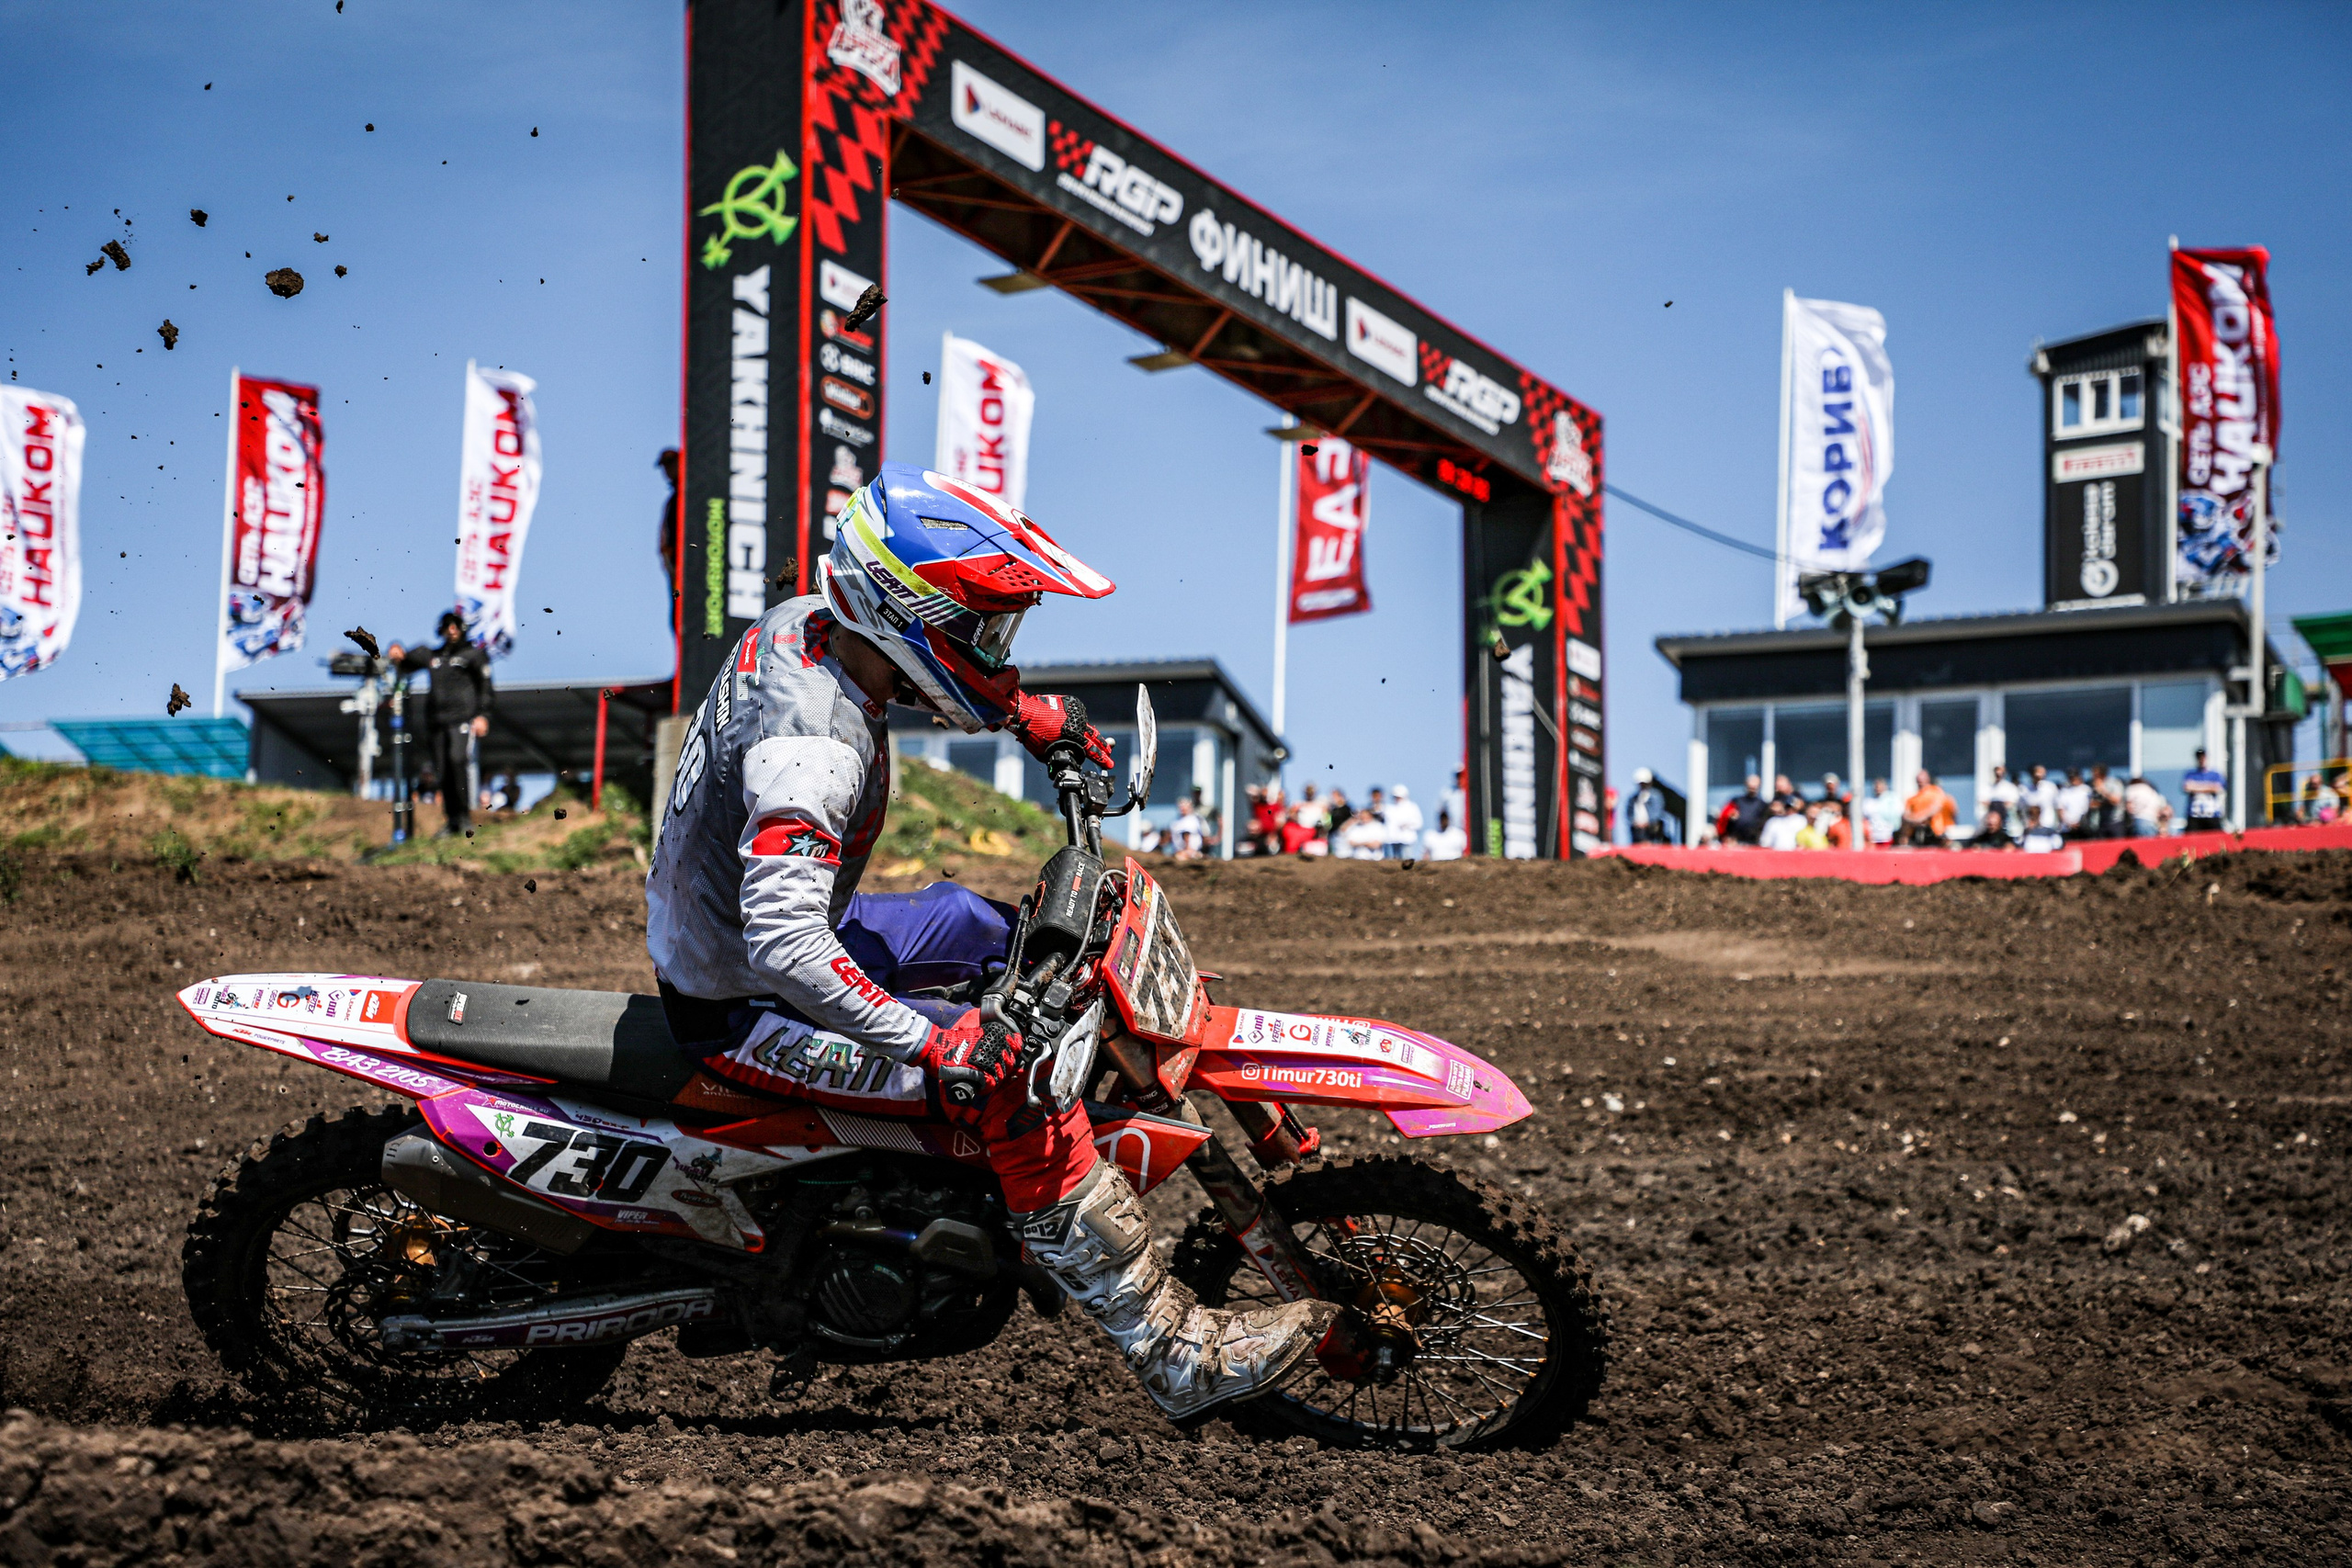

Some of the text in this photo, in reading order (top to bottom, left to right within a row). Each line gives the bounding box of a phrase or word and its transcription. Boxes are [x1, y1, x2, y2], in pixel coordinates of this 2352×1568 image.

[1082, 144, 1184, 226] RGP
[1189, 208, 1338, 342] ФИНИШ
[1443, 358, 1521, 425] RGP
[728, 264, 771, 620] YAKHINICH
[977, 358, 1004, 494] UKOM
[707, 498, 726, 638] MOTORSPORT
[865, 560, 922, 599] LEATT
[883, 608, 899, 625] ЭТАП
[970, 616, 986, 647] LEATT
[1066, 862, 1086, 919] READY TO RACE
[366, 992, 380, 1020] KTM
[830, 956, 899, 1009] LEATT
[953, 1040, 969, 1066] LEATT
[1272, 1019, 1283, 1043] VERTEX
[1311, 1023, 1321, 1046] GIBSON
[375, 1065, 434, 1089] 2105
[752, 1025, 896, 1093] LEATT
[1261, 1065, 1363, 1089] Timur730ti
[507, 1121, 673, 1204] 730
[526, 1299, 715, 1346] PRIRODA
